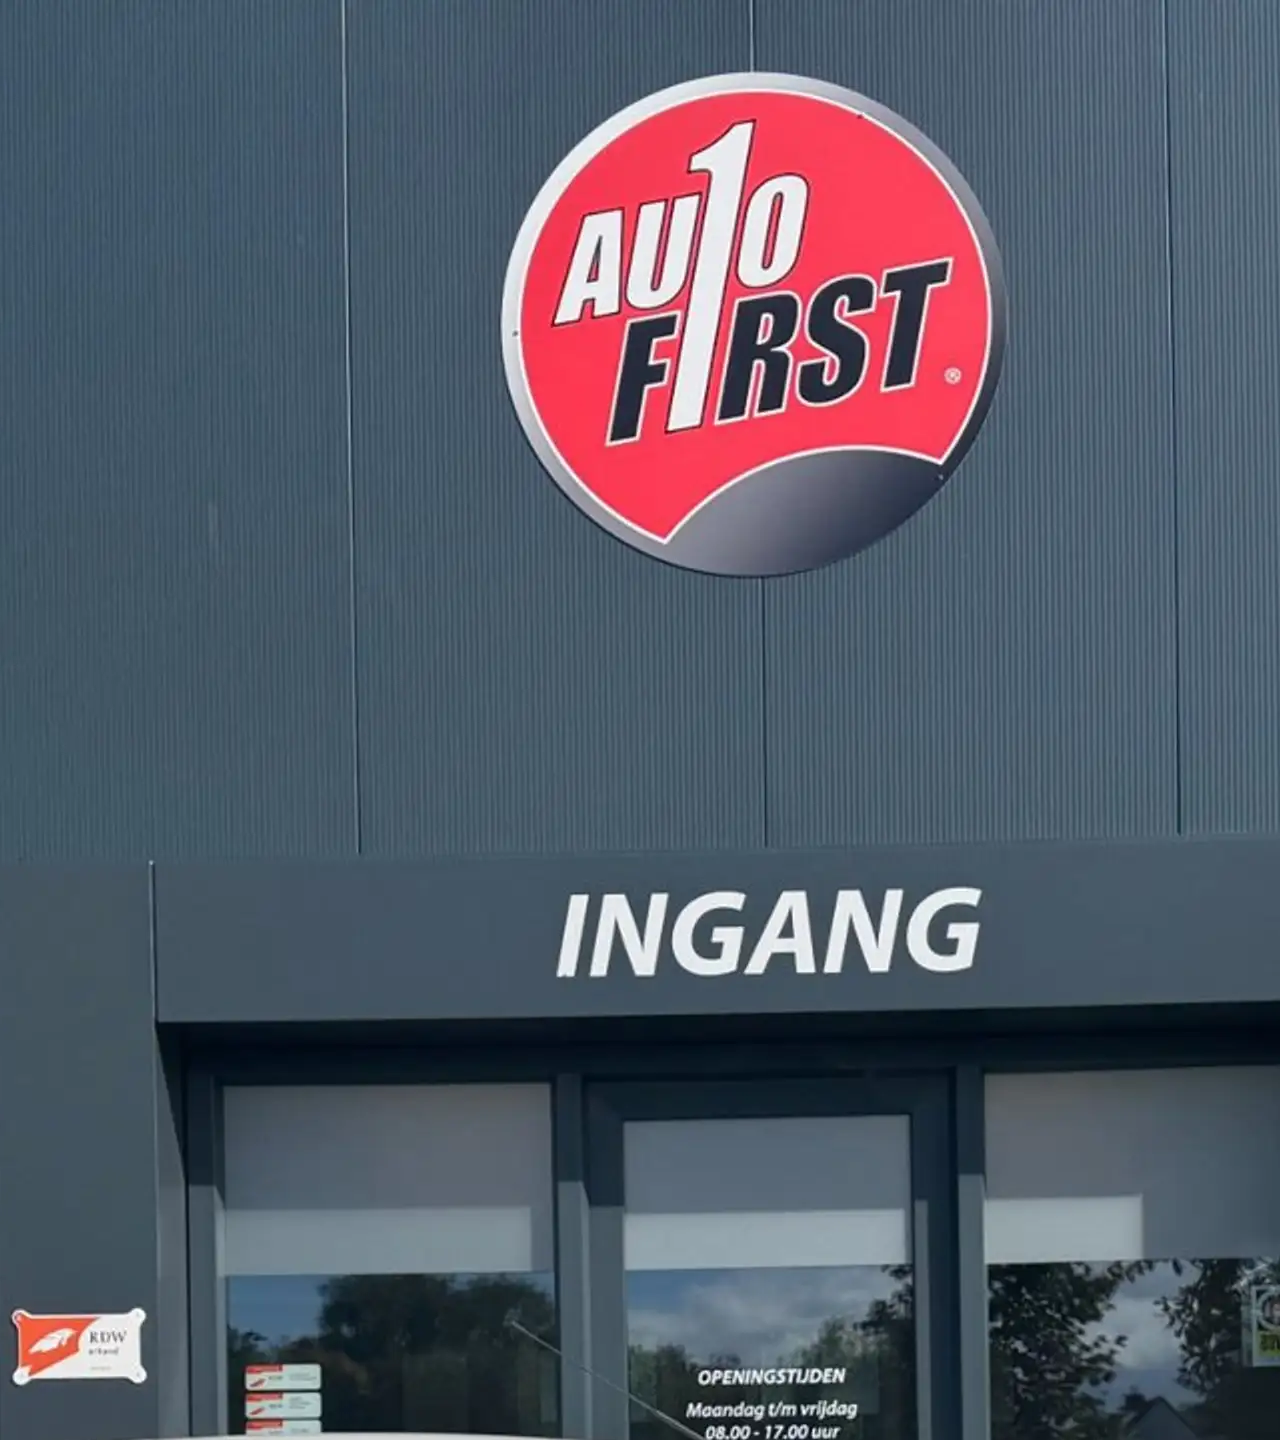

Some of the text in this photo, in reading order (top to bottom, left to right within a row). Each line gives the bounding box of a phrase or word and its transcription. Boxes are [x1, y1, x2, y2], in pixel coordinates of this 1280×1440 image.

[556, 887, 983, 977] INGANG
[698, 1367, 846, 1386] OPENINGSTIJDEN
[686, 1400, 858, 1421] Maandag t/m vrijdag
[705, 1425, 751, 1440] 08.00
[765, 1425, 809, 1440] 17.00
[811, 1427, 841, 1439] uur
